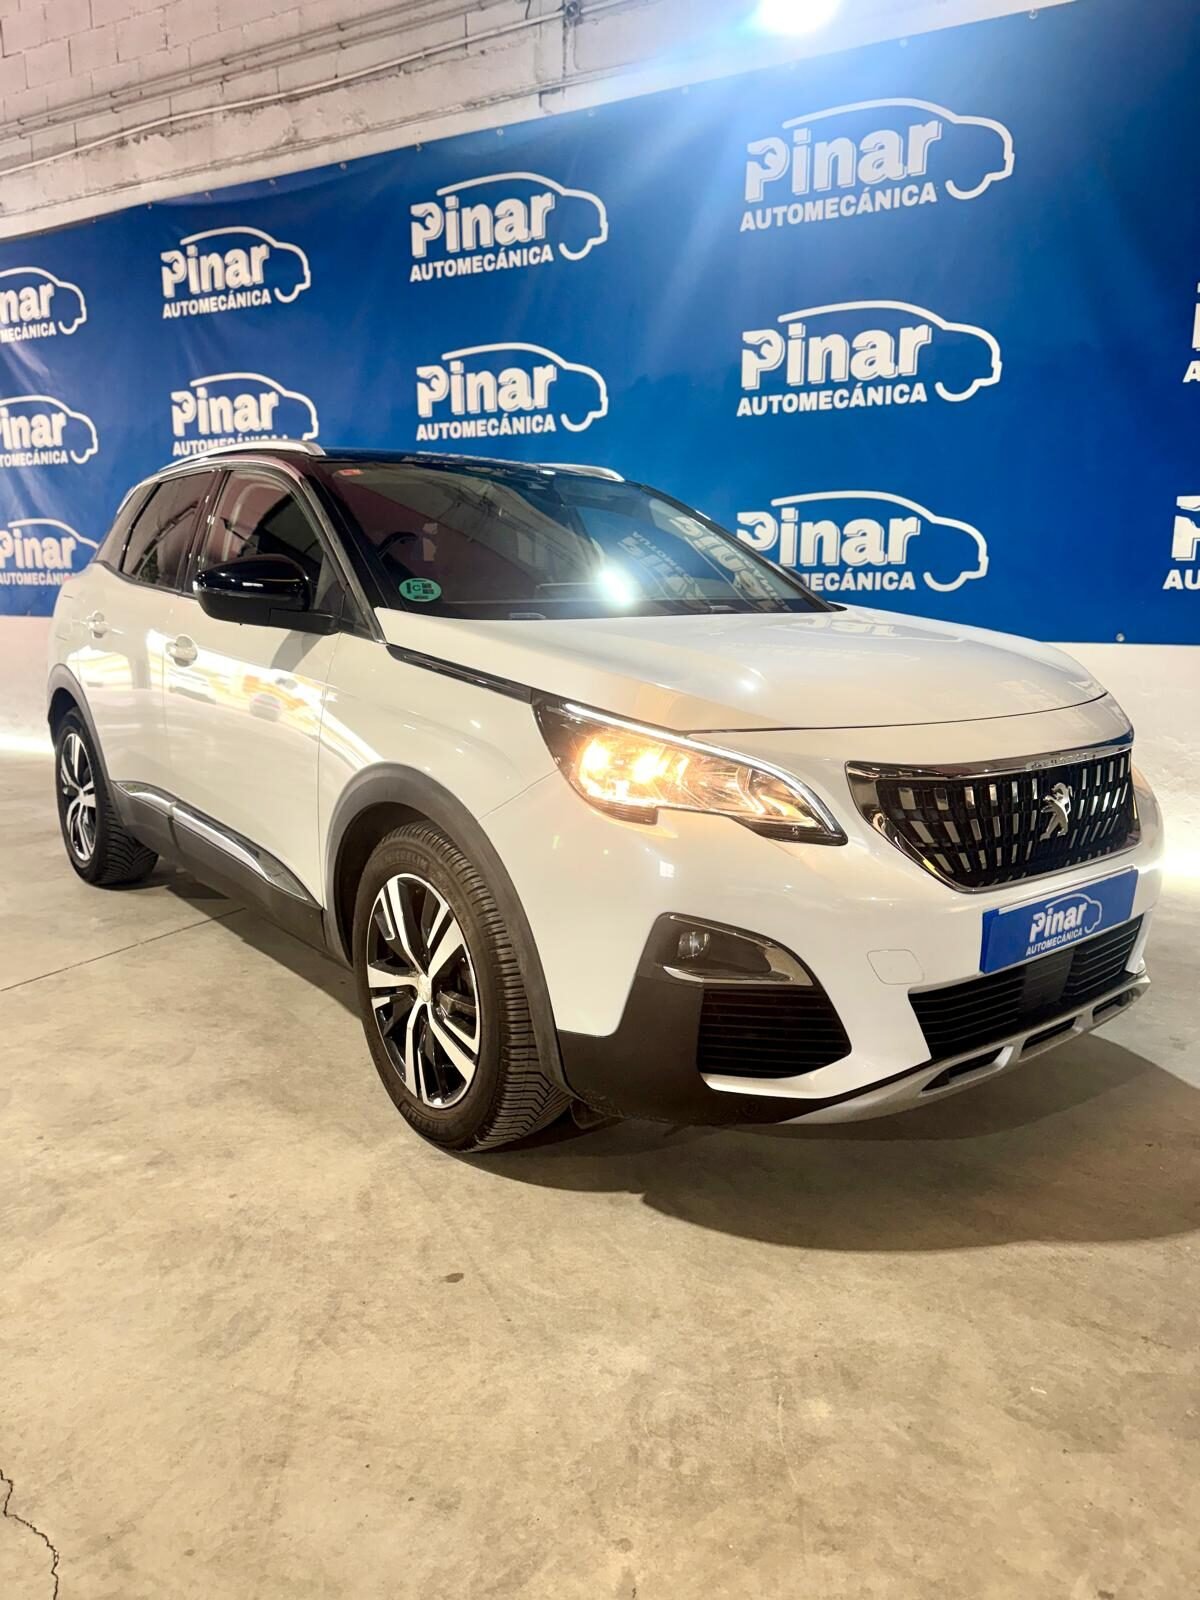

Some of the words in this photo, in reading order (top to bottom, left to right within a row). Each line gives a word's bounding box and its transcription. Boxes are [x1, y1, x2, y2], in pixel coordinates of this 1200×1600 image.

[744, 119, 942, 203] Pinar
[410, 192, 555, 258] Pinar
[740, 181, 938, 232] AUTOMECÁNICA
[161, 242, 270, 298] Pinar
[410, 245, 554, 282] AUTOMECÁNICA
[0, 283, 55, 324] nar
[162, 289, 272, 319] AUTOMECÁNICA
[0, 321, 57, 343] MECÁNICA
[741, 321, 932, 391] Pinar
[416, 360, 557, 418] Pinar
[736, 381, 928, 417] AUTOMECÁNICA
[0, 407, 67, 450] inar
[171, 387, 279, 437] Pinar
[416, 413, 557, 441] AUTOMECÁNICA
[0, 448, 69, 467] TOMECÁNICA
[0, 528, 77, 569] Pinar
[736, 507, 921, 567] Pinar
[801, 568, 916, 591] ECÁNICA
[1026, 927, 1083, 957] AUTOMECÁNICA
[1029, 902, 1087, 942] Pinar
